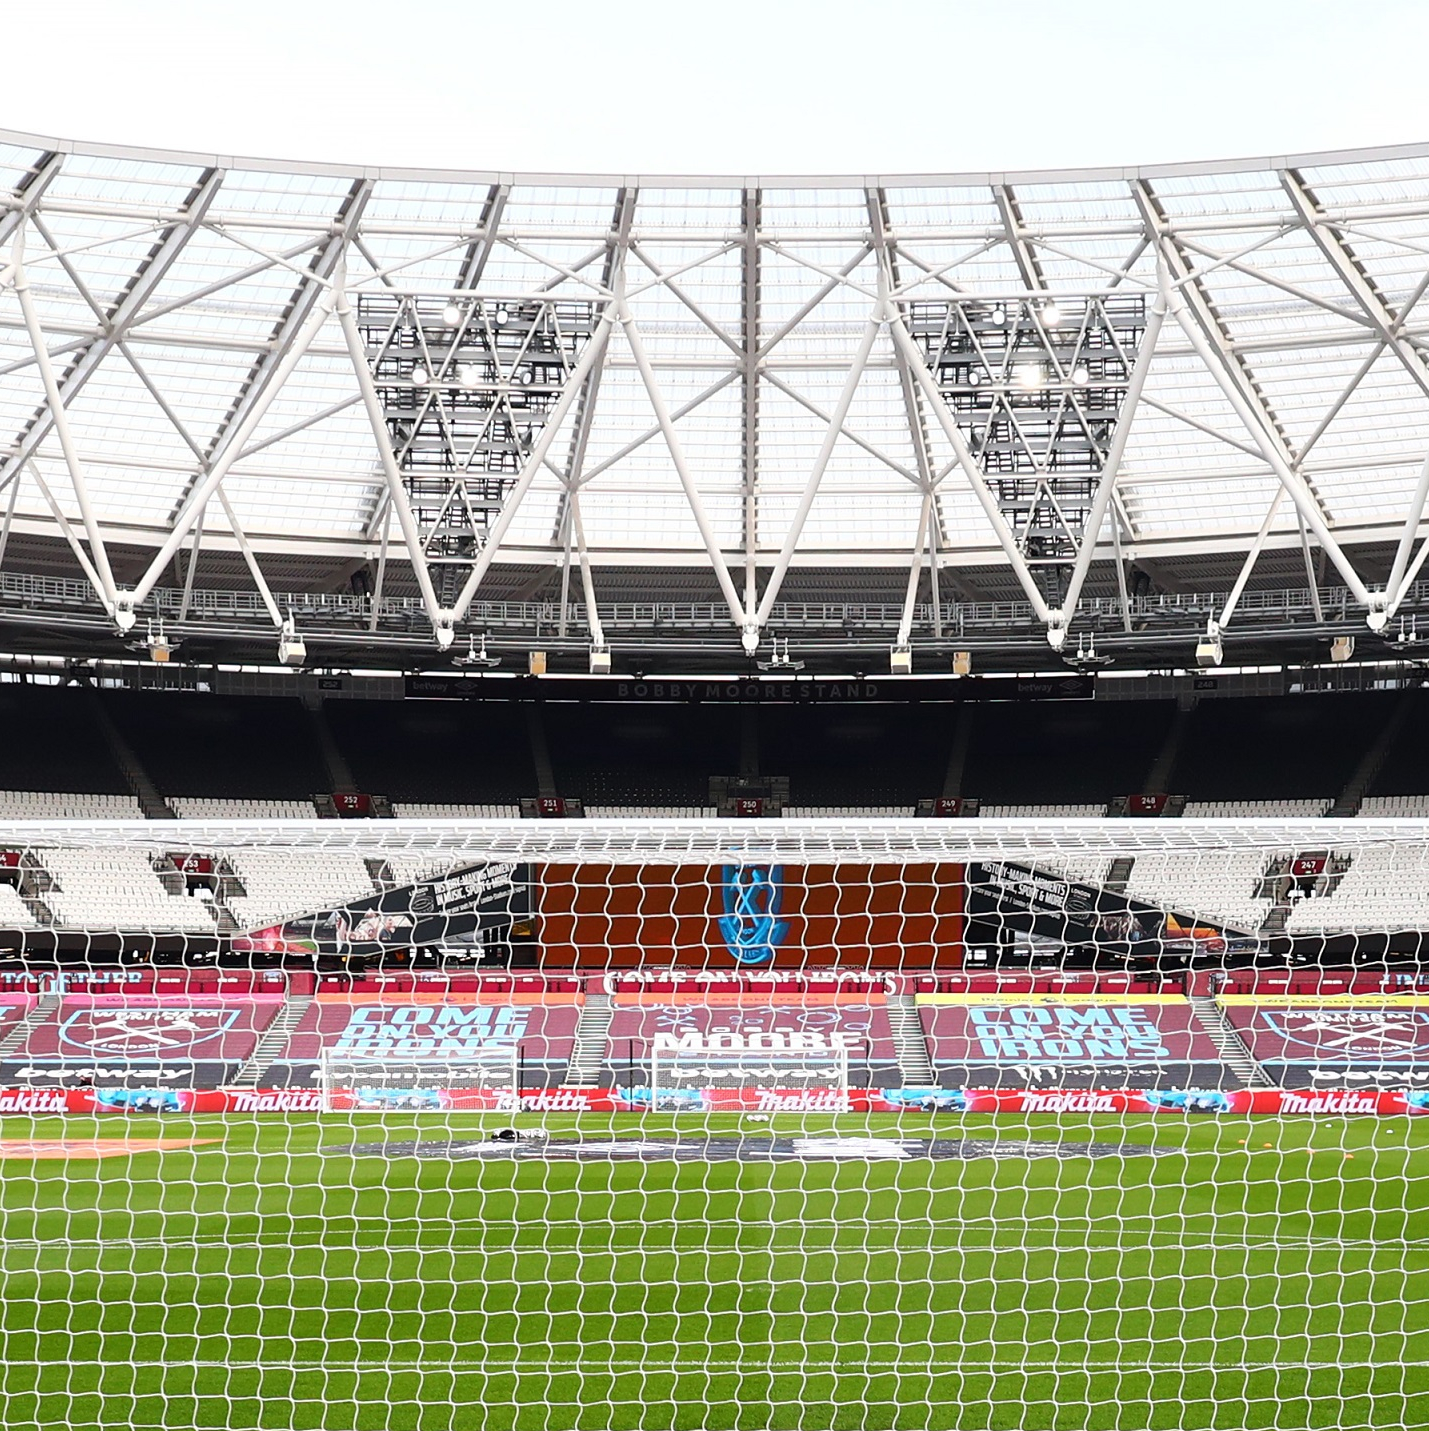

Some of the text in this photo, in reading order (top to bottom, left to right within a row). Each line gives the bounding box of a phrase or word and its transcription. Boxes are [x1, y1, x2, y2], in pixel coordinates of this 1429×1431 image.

[412, 682, 448, 692] betway
[619, 684, 879, 698] BOBBY MOORE STAND
[1017, 682, 1053, 693] betway
[343, 796, 359, 804] 252
[543, 799, 557, 807] 251
[742, 800, 757, 808] 250
[941, 800, 956, 808] 249
[1141, 796, 1156, 805] 248
[1301, 860, 1316, 869] 247
[350, 1007, 533, 1025] COME
[970, 1007, 1153, 1025] COME
[341, 1024, 528, 1039] ON YOU
[975, 1025, 1162, 1039] ON YOU
[332, 1038, 519, 1056] IRONS
[653, 1031, 865, 1051] MOORE
[980, 1039, 1170, 1057] IRONS
[14, 1067, 192, 1080] betway
